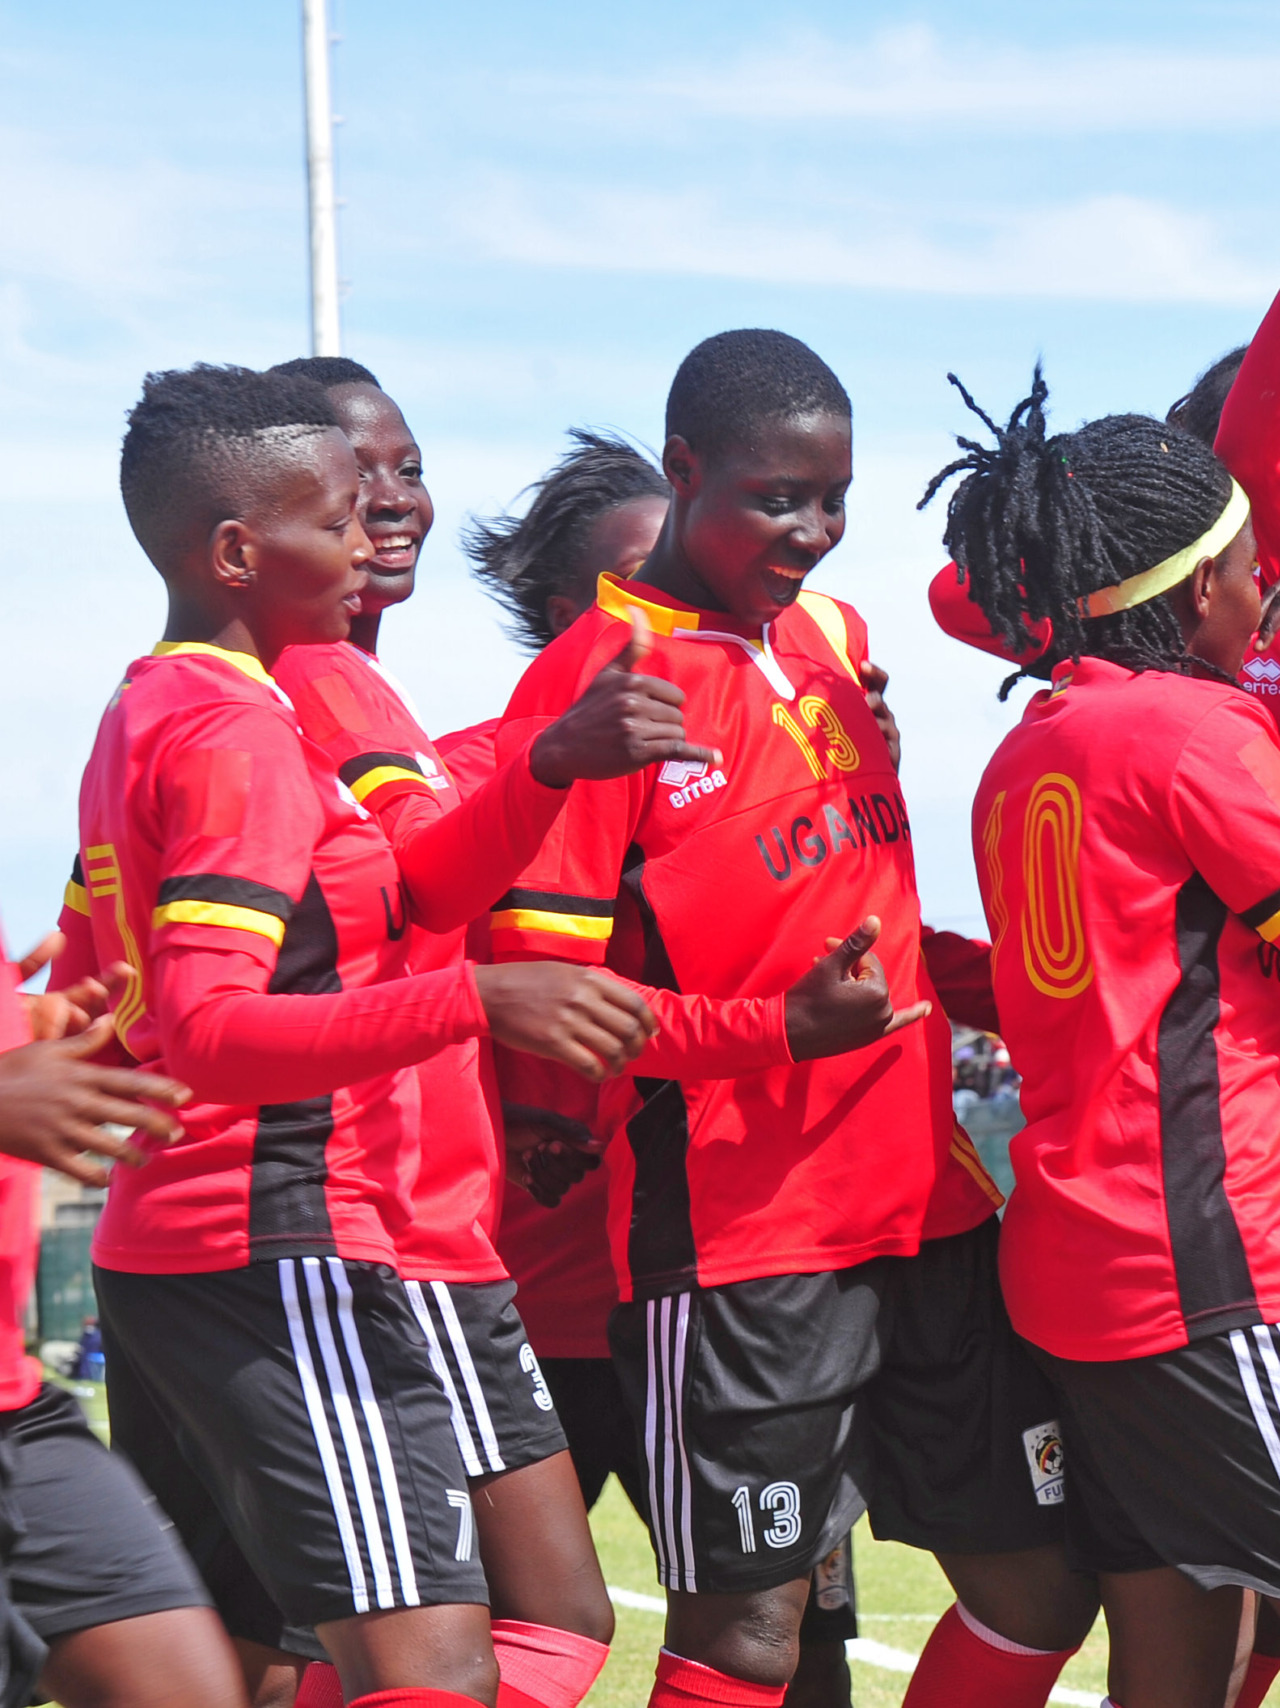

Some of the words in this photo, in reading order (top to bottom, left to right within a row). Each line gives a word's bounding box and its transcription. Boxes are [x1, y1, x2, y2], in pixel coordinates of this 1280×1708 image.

[772, 695, 860, 781] 13
[668, 769, 728, 809] errea
[982, 772, 1095, 999] 10
[519, 1343, 554, 1411] 3
[445, 1489, 473, 1562] 7
[731, 1481, 802, 1554] 13
